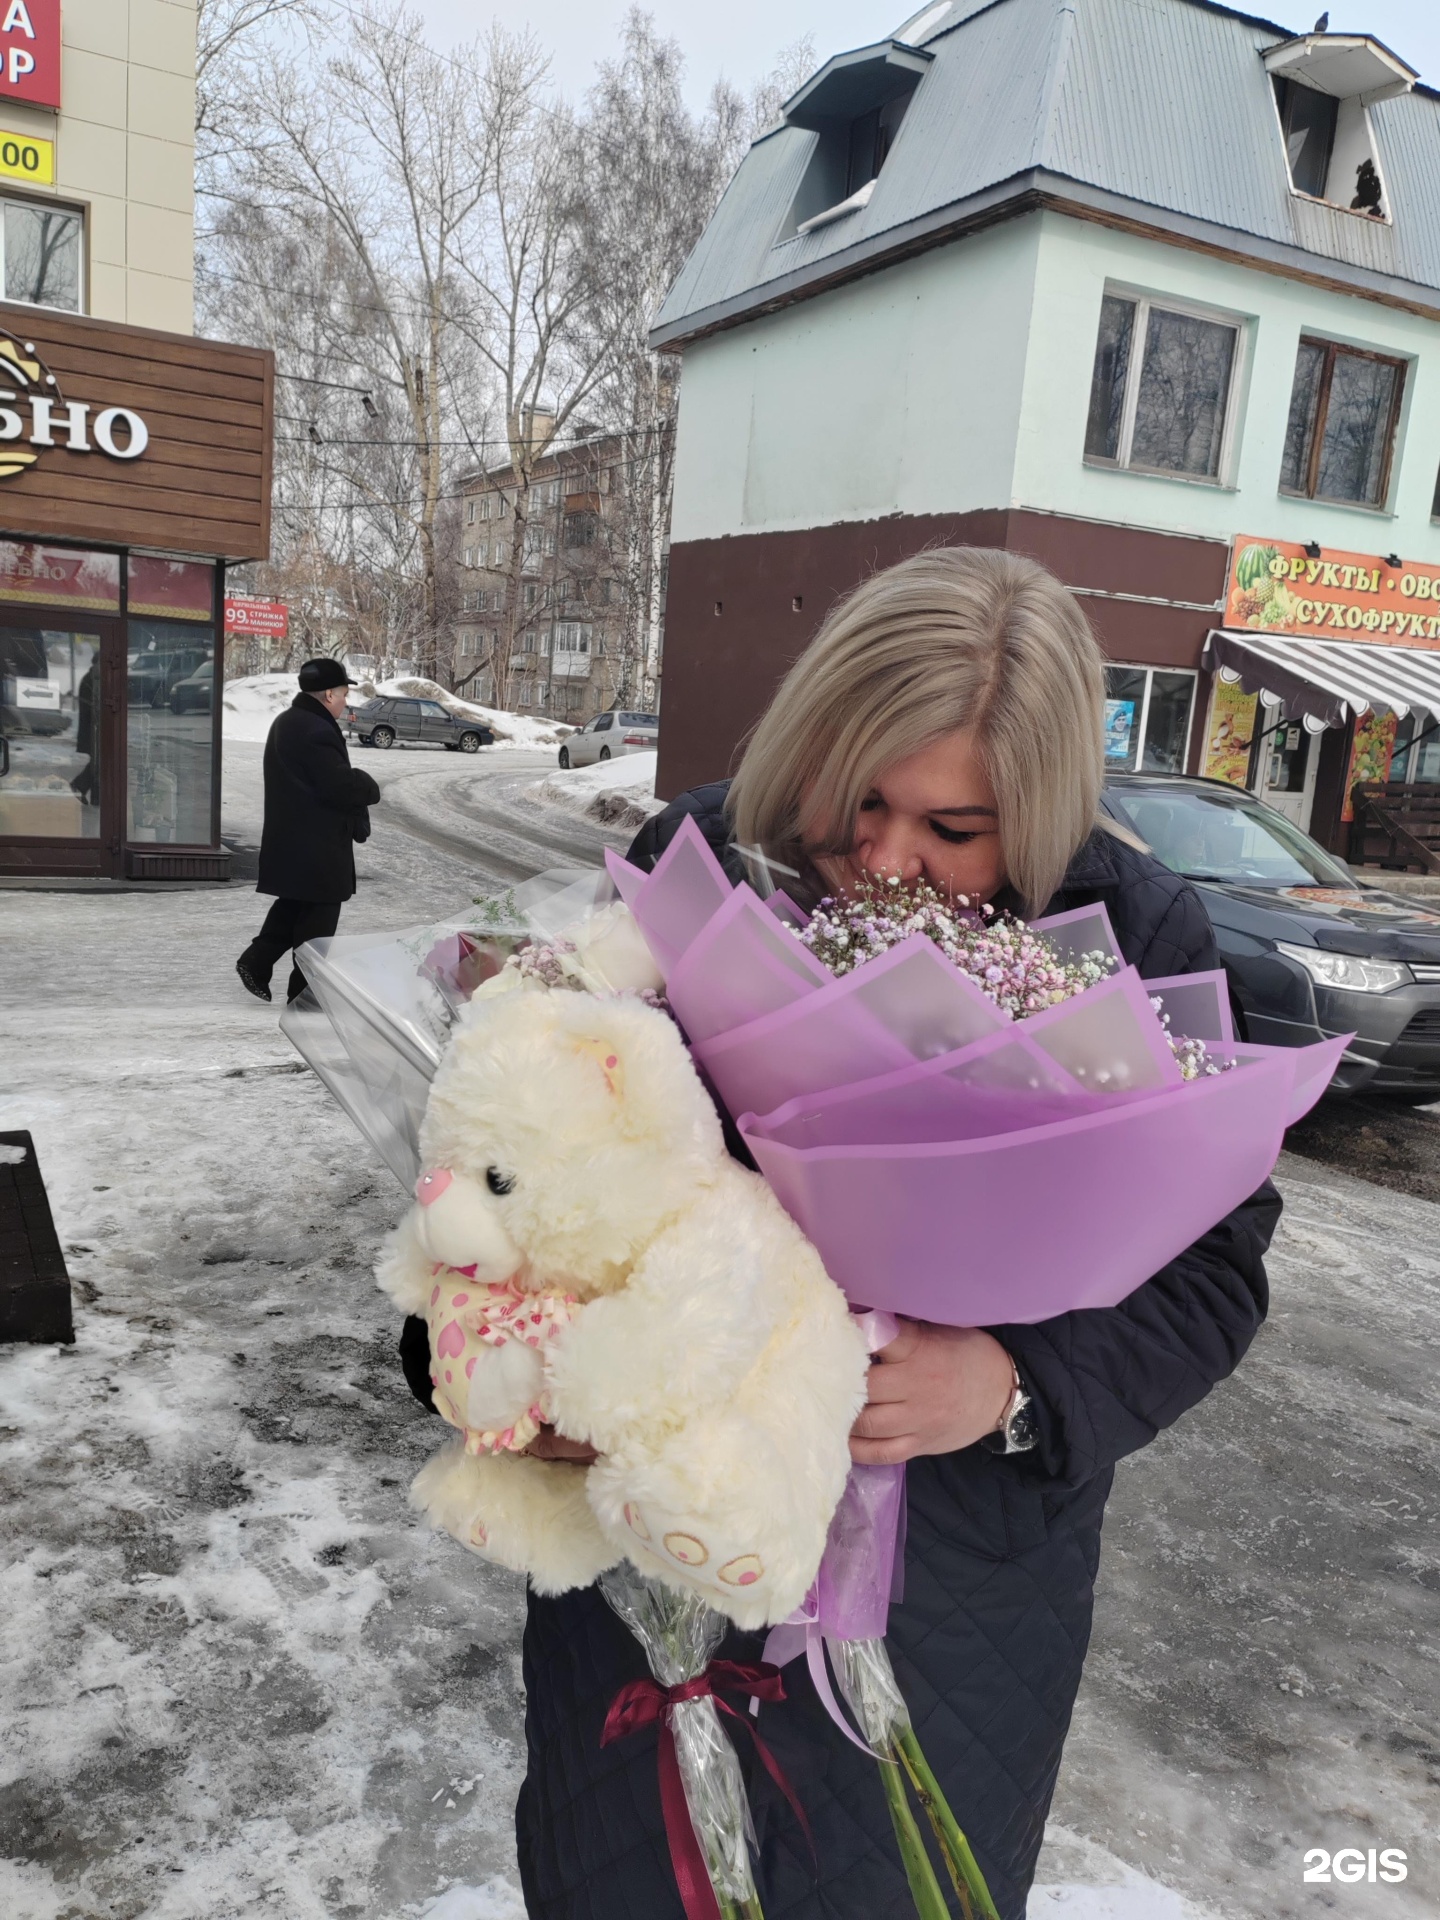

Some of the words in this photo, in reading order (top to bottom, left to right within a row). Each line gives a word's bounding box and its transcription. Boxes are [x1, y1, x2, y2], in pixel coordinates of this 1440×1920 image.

[0, 47, 35, 83] Р
[1268, 555, 1381, 592] ФРУКТЫ
[249, 611, 284, 620] СТРИЖКА
[250, 619, 284, 628] МАНИКЮР
